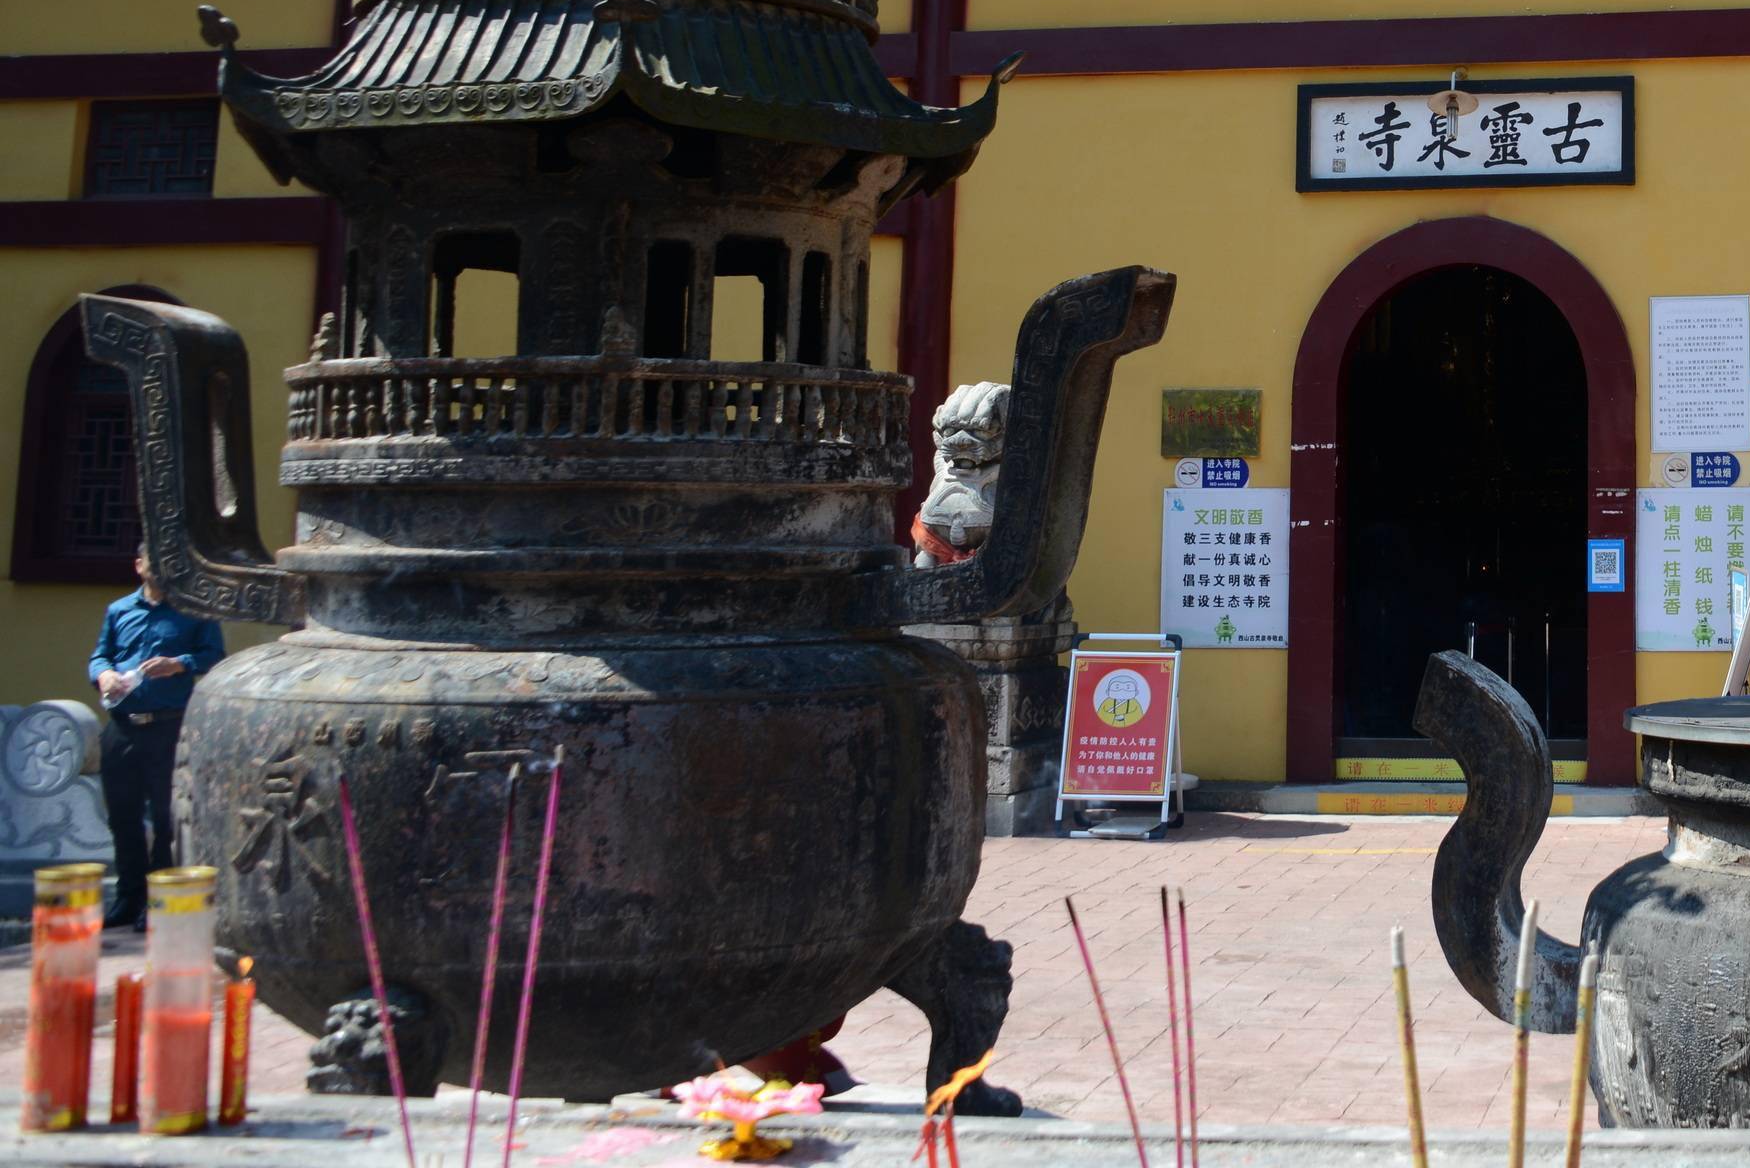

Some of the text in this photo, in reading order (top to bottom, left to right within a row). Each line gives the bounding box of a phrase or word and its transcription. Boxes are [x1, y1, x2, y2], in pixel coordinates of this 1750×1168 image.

[1206, 459, 1241, 469] 进入寺院
[1695, 456, 1732, 466] 进入寺院
[1206, 470, 1241, 480] 禁止吸烟
[1696, 468, 1732, 478] 禁止吸烟
[1194, 509, 1264, 526] 文明敬香
[1183, 532, 1272, 545] 敬三支健康香
[1183, 553, 1272, 566] 献一份真诚心
[1694, 505, 1713, 615] 蜡烛纸钱
[1183, 574, 1272, 587] 倡导文明敬香
[1182, 595, 1272, 608] 建设生态寺院
[1080, 736, 1156, 746] 疫情防控人人有责
[1078, 751, 1155, 760] 为了你和他人的健康
[1077, 765, 1154, 774] 请自觉佩戴好口罩
